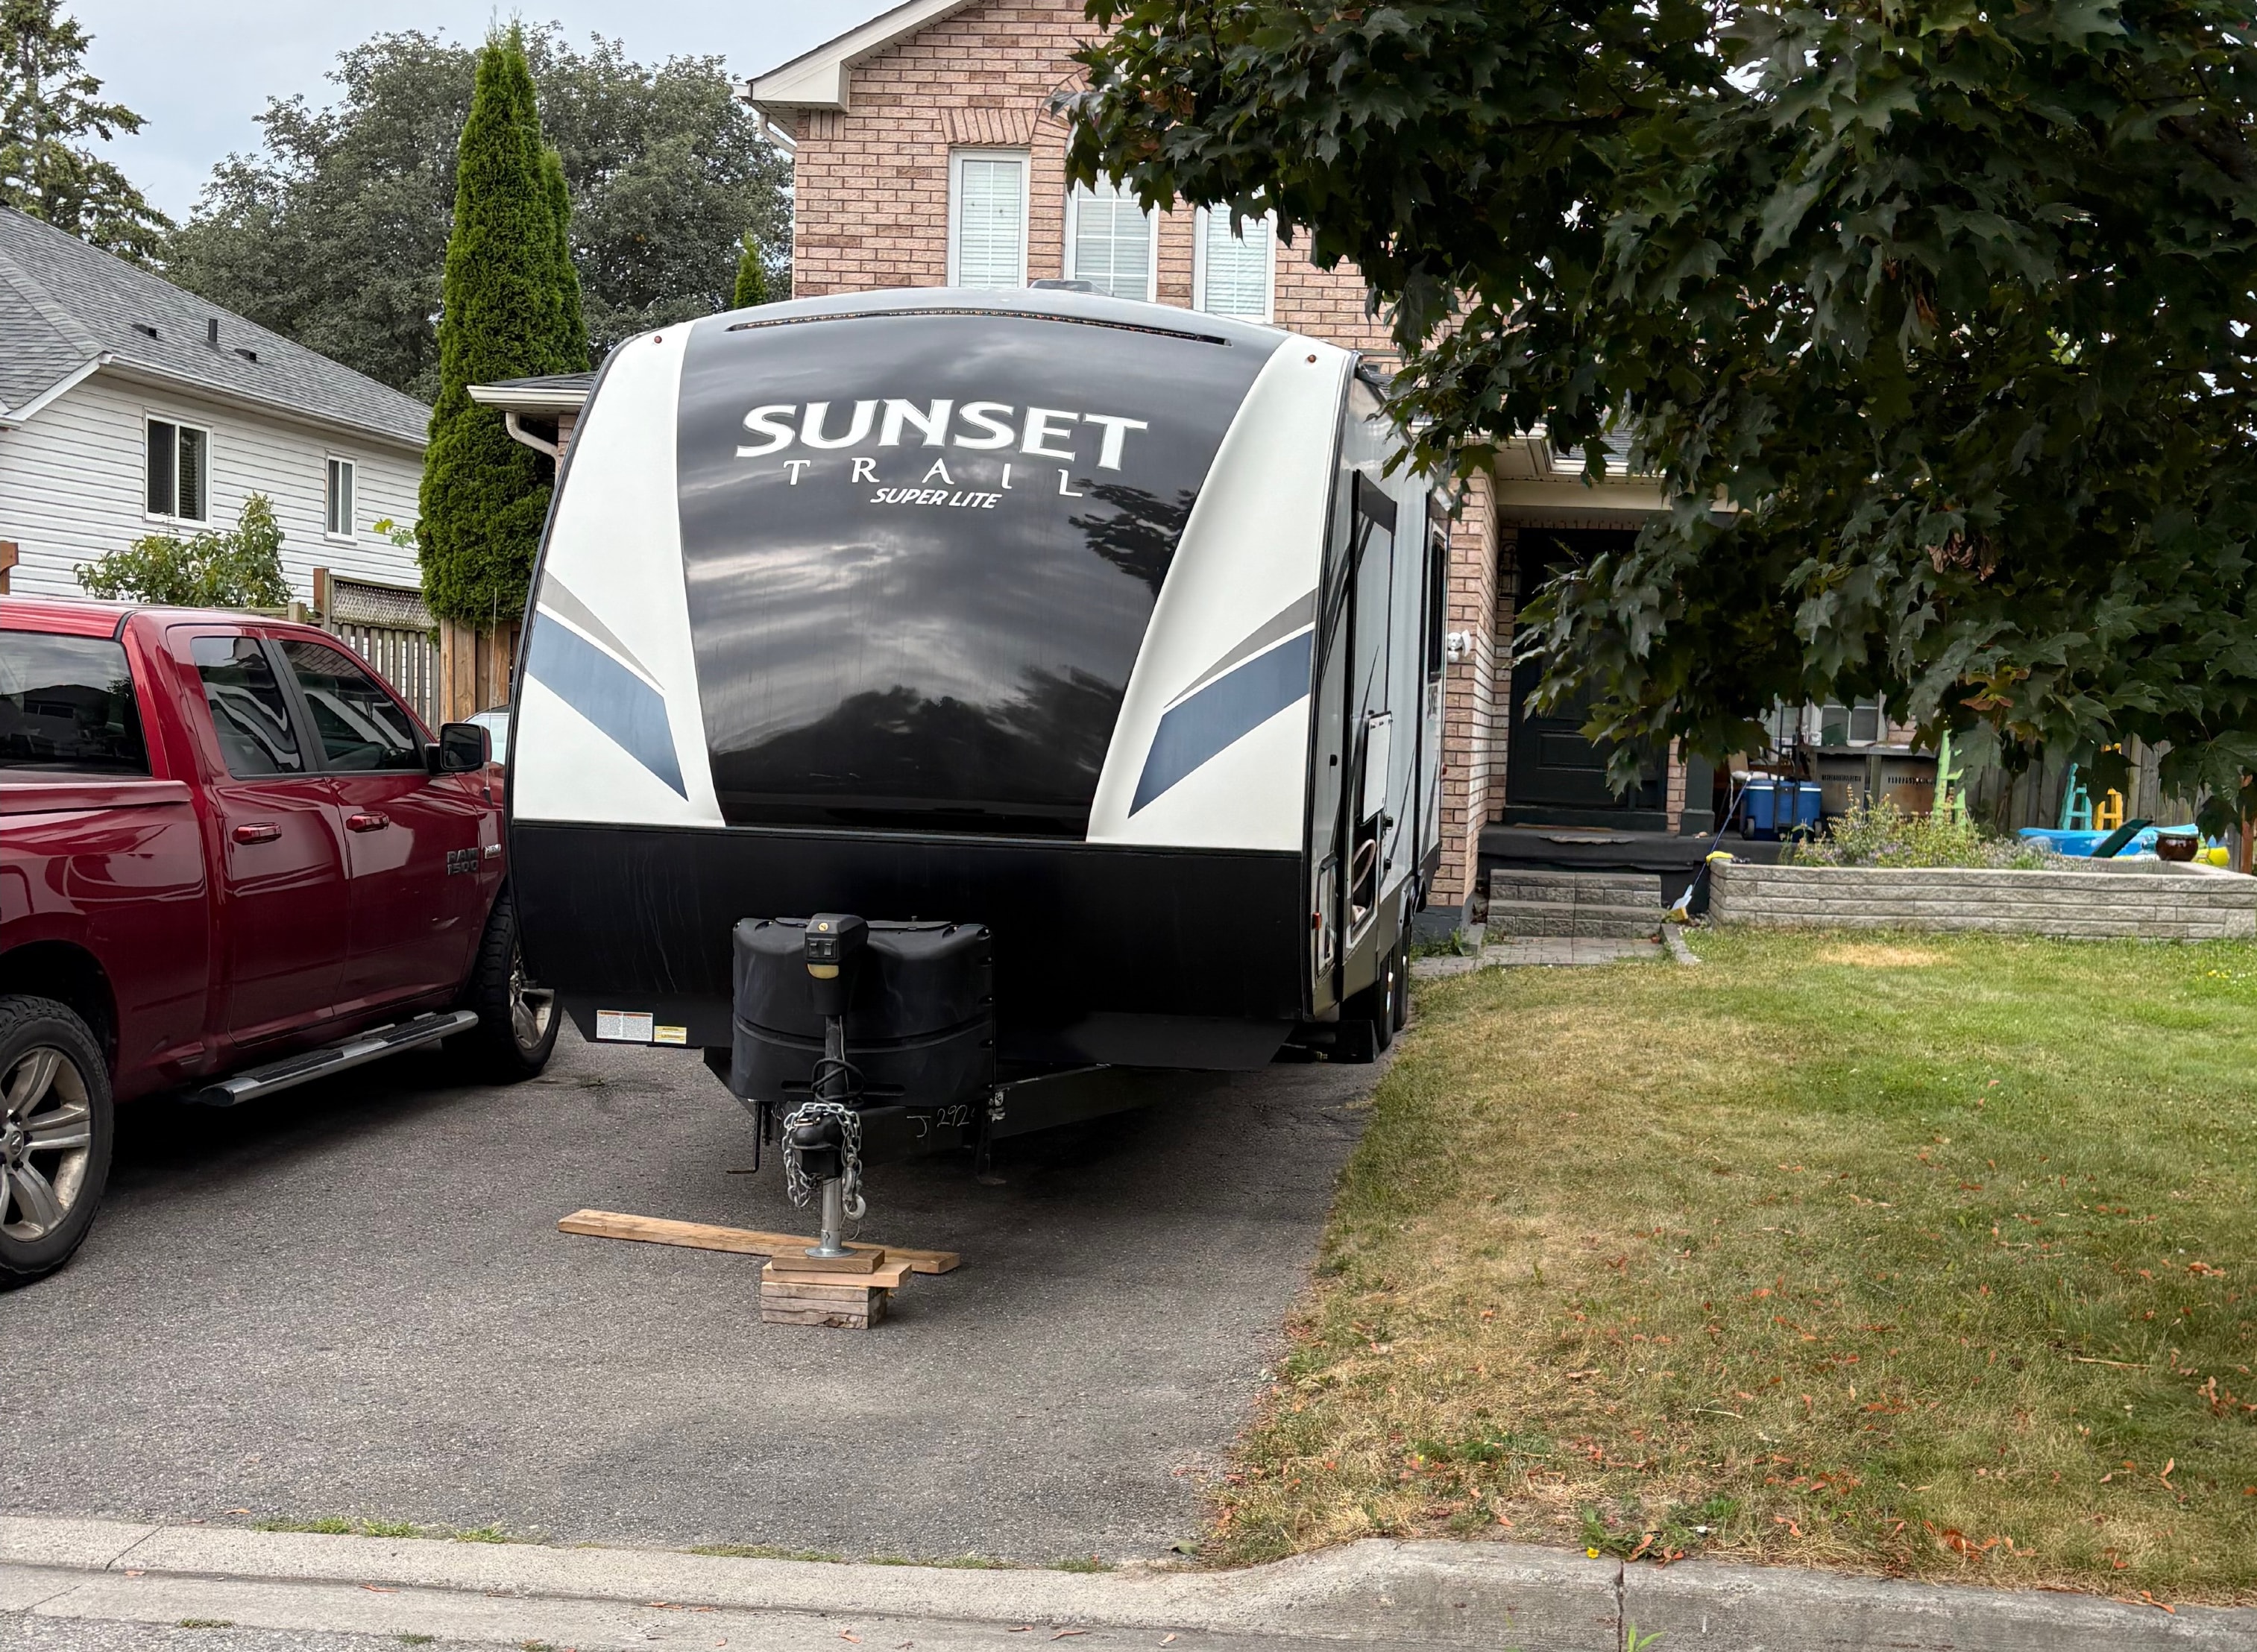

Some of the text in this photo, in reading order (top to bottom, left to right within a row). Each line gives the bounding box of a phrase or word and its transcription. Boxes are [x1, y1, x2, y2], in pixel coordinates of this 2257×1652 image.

[735, 399, 1148, 471] SUNSET
[783, 457, 1083, 497] TRAIL
[870, 488, 1002, 508] SUPER LITE
[447, 848, 478, 863] RAM
[447, 860, 478, 876] 1500
